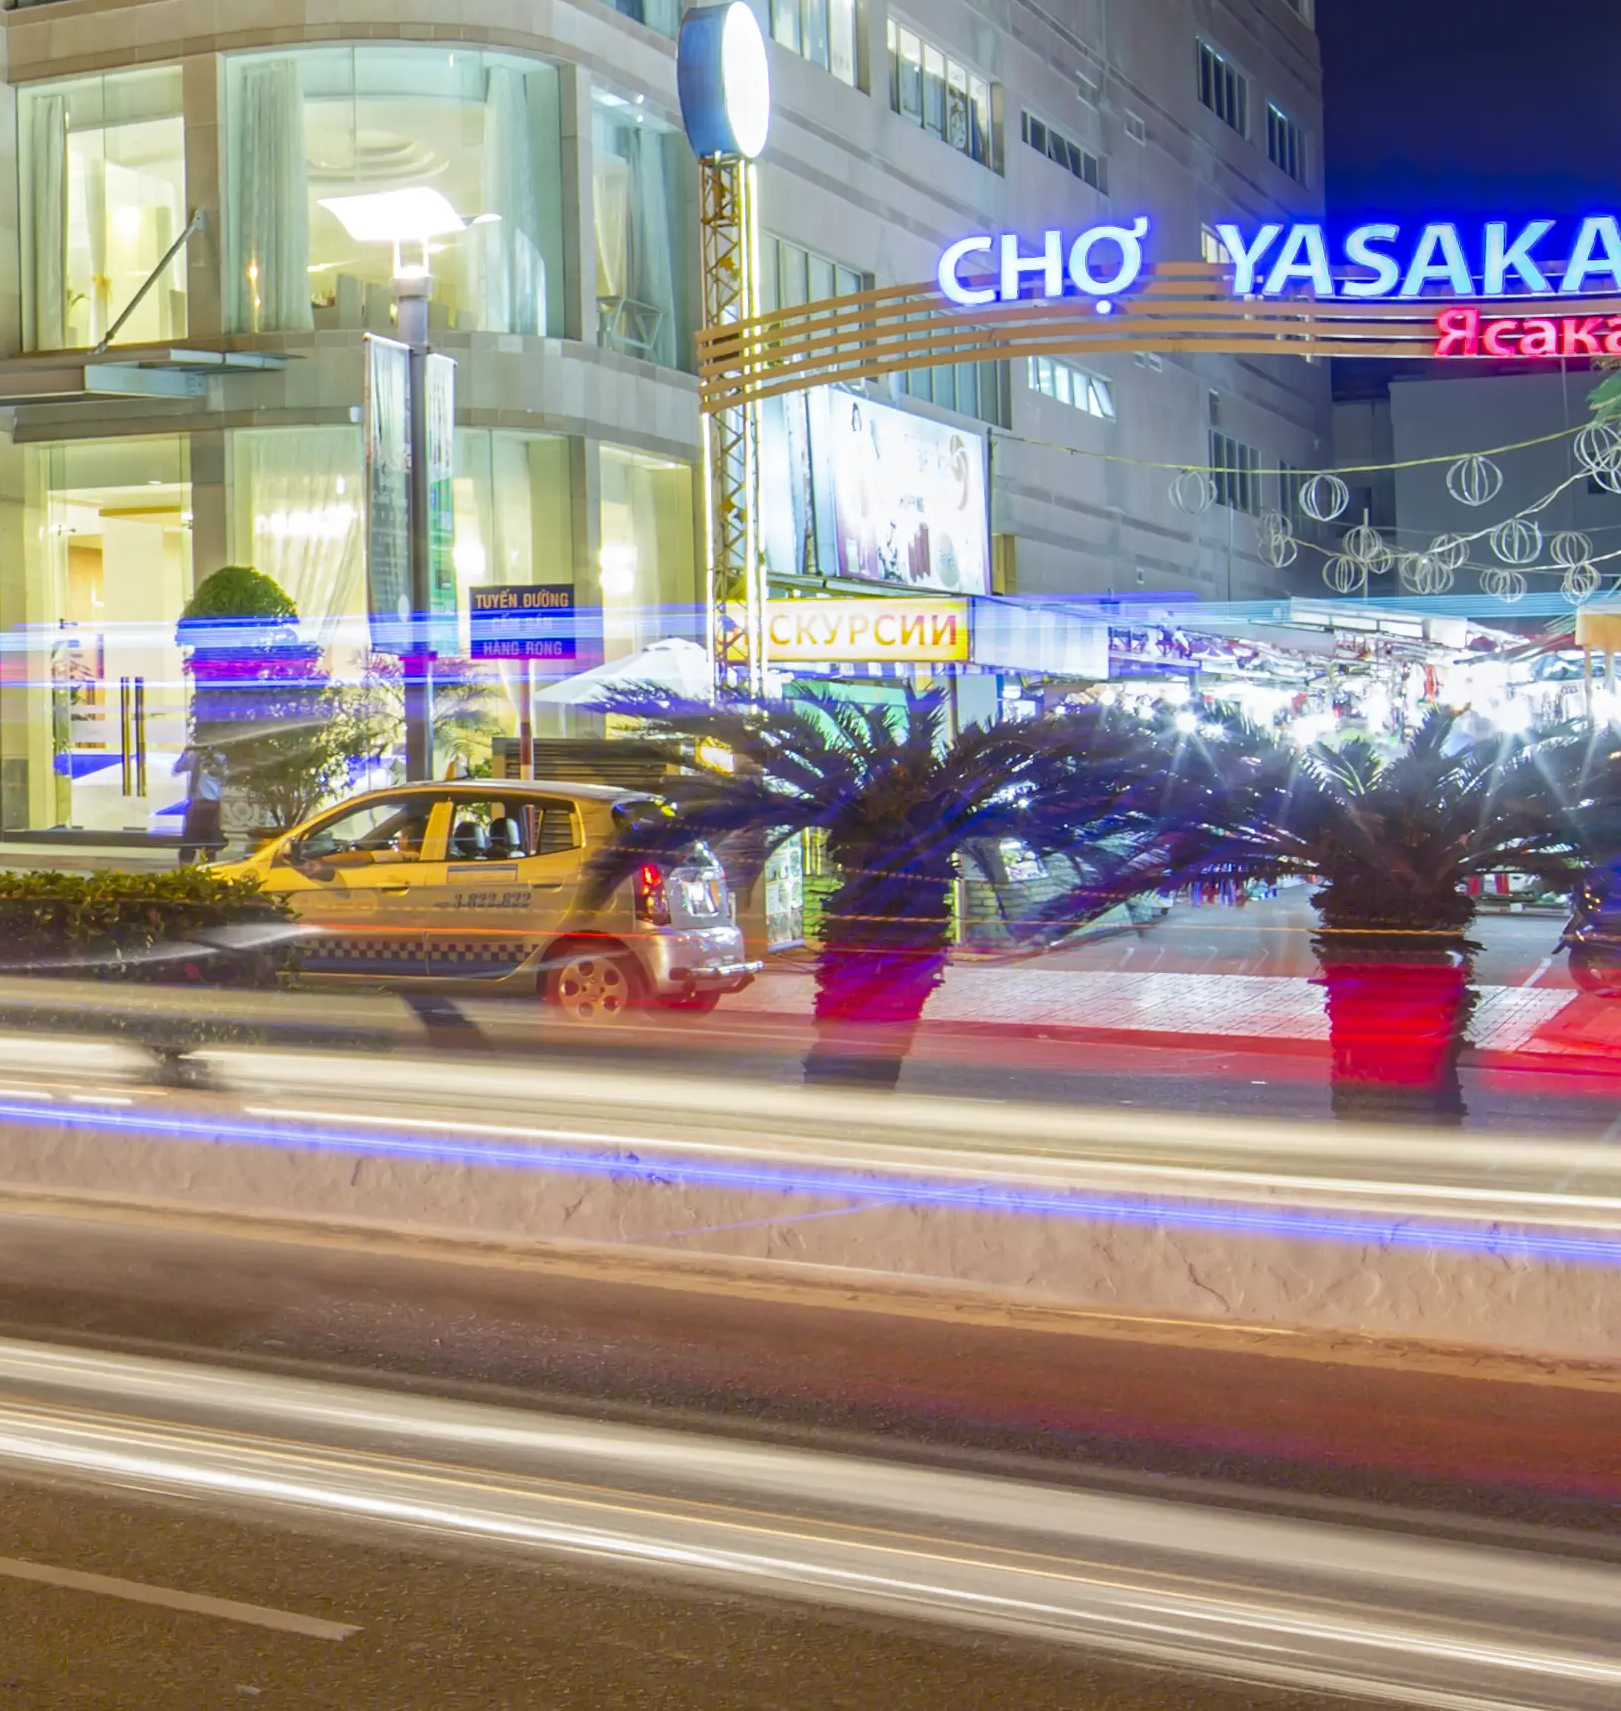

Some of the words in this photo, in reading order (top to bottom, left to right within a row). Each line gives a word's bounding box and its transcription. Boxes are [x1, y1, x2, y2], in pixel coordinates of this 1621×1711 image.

[936, 215, 1151, 315] CHỢ
[1215, 214, 1621, 298] YASAKA
[715, 613, 957, 647] СКУРСИИ
